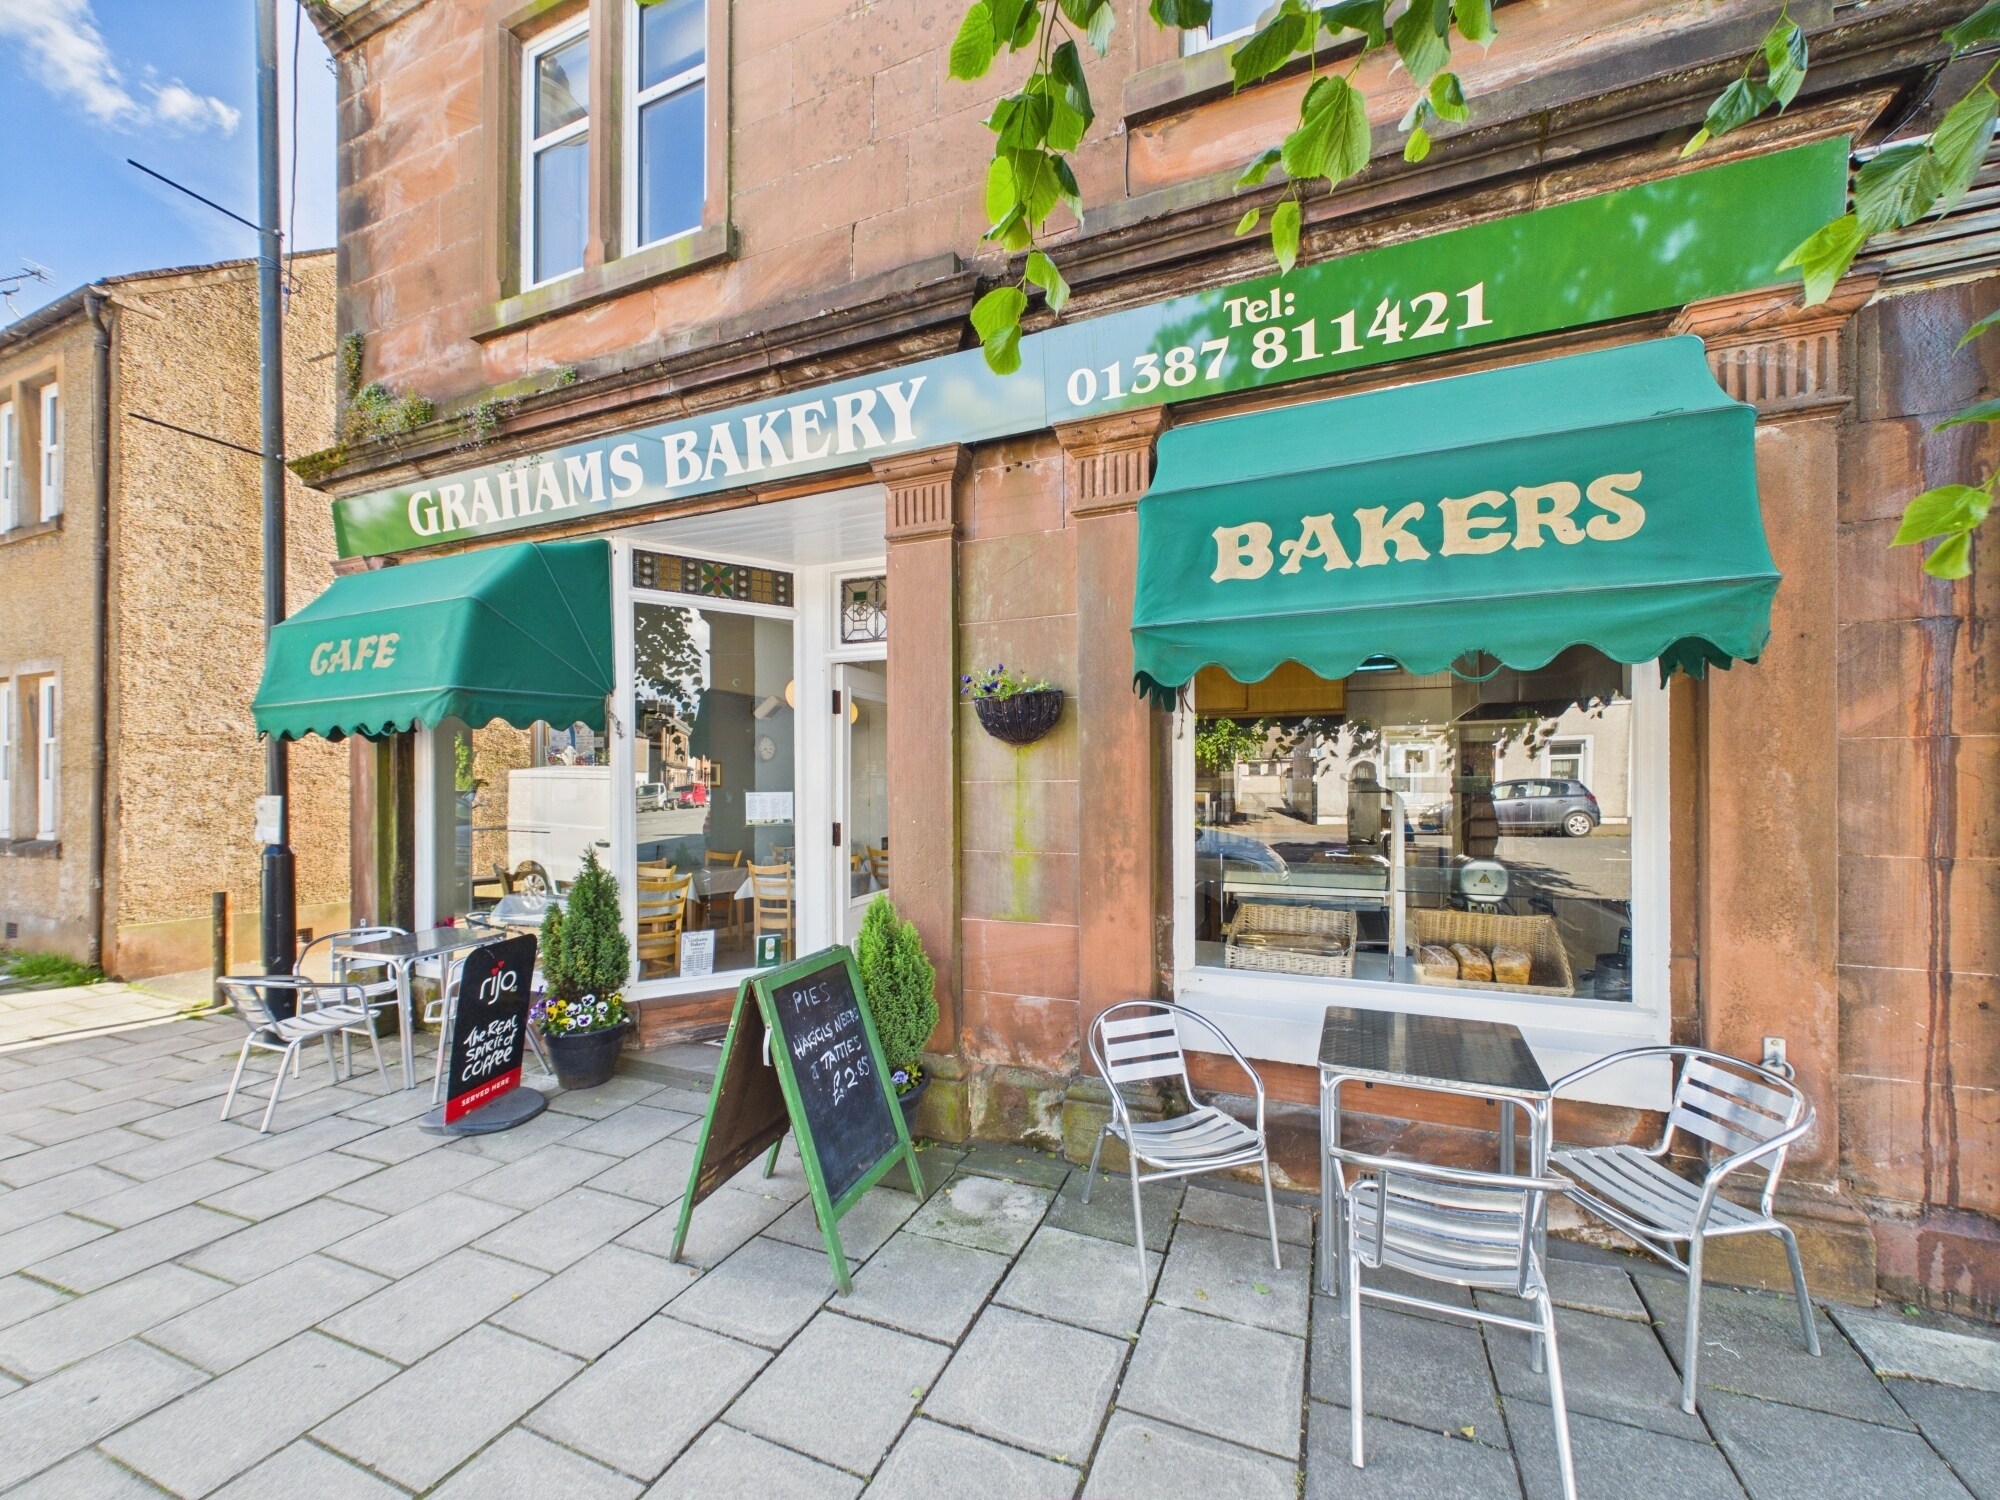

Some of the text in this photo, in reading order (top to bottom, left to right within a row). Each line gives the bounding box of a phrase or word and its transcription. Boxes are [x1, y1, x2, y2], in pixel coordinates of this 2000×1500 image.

[1223, 288, 1295, 329] Tel:
[1067, 281, 1493, 406] 01387 811421
[408, 376, 927, 537] GRAHAMS BAKERY
[1210, 470, 1645, 584] BAKERS
[792, 982, 830, 1013] PIES
[463, 1015, 518, 1048] The REAL
[504, 1028, 518, 1045] of
[820, 1035, 862, 1070] TATTIES
[461, 1077, 510, 1107] SERVED HERE
